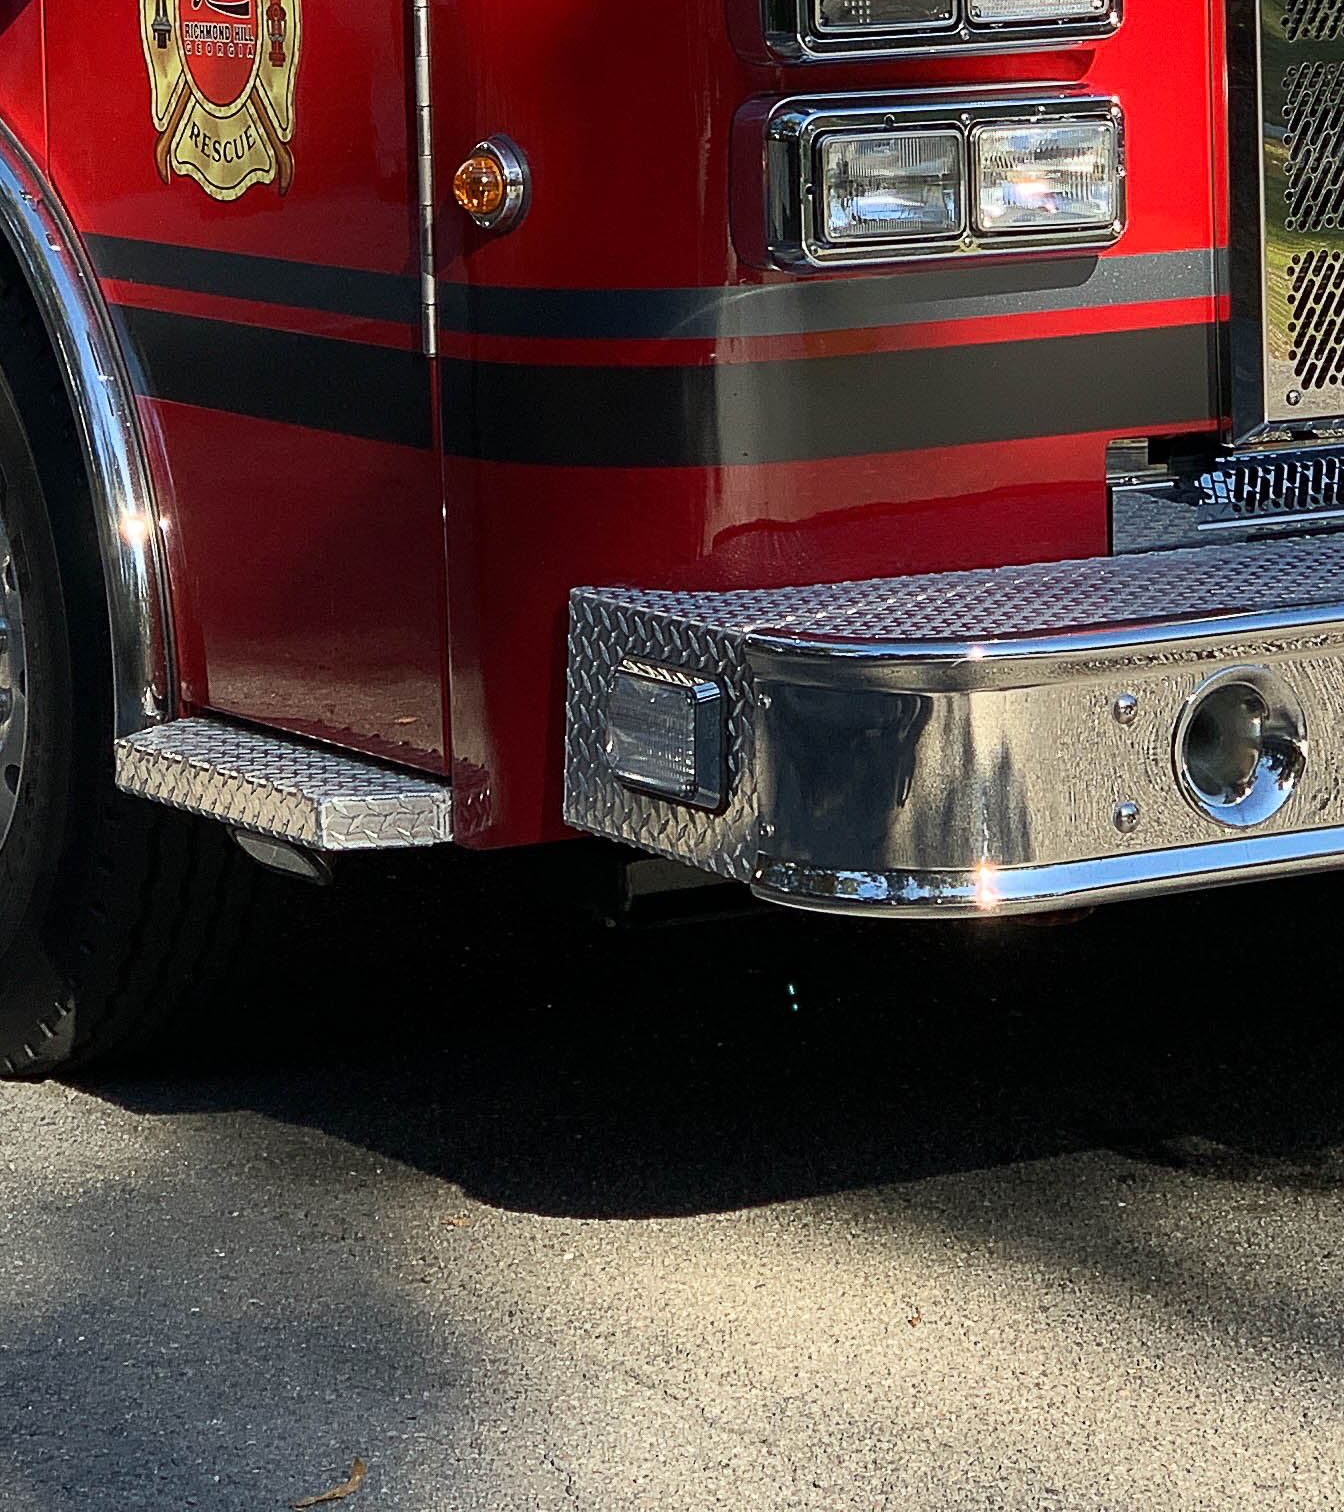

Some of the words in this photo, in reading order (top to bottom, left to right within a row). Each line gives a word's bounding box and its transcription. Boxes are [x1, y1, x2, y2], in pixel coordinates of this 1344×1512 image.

[184, 21, 231, 42] RICHMOND
[233, 23, 255, 43] HILL
[184, 42, 255, 59] GEORGIA
[189, 121, 256, 164] RESCUE
